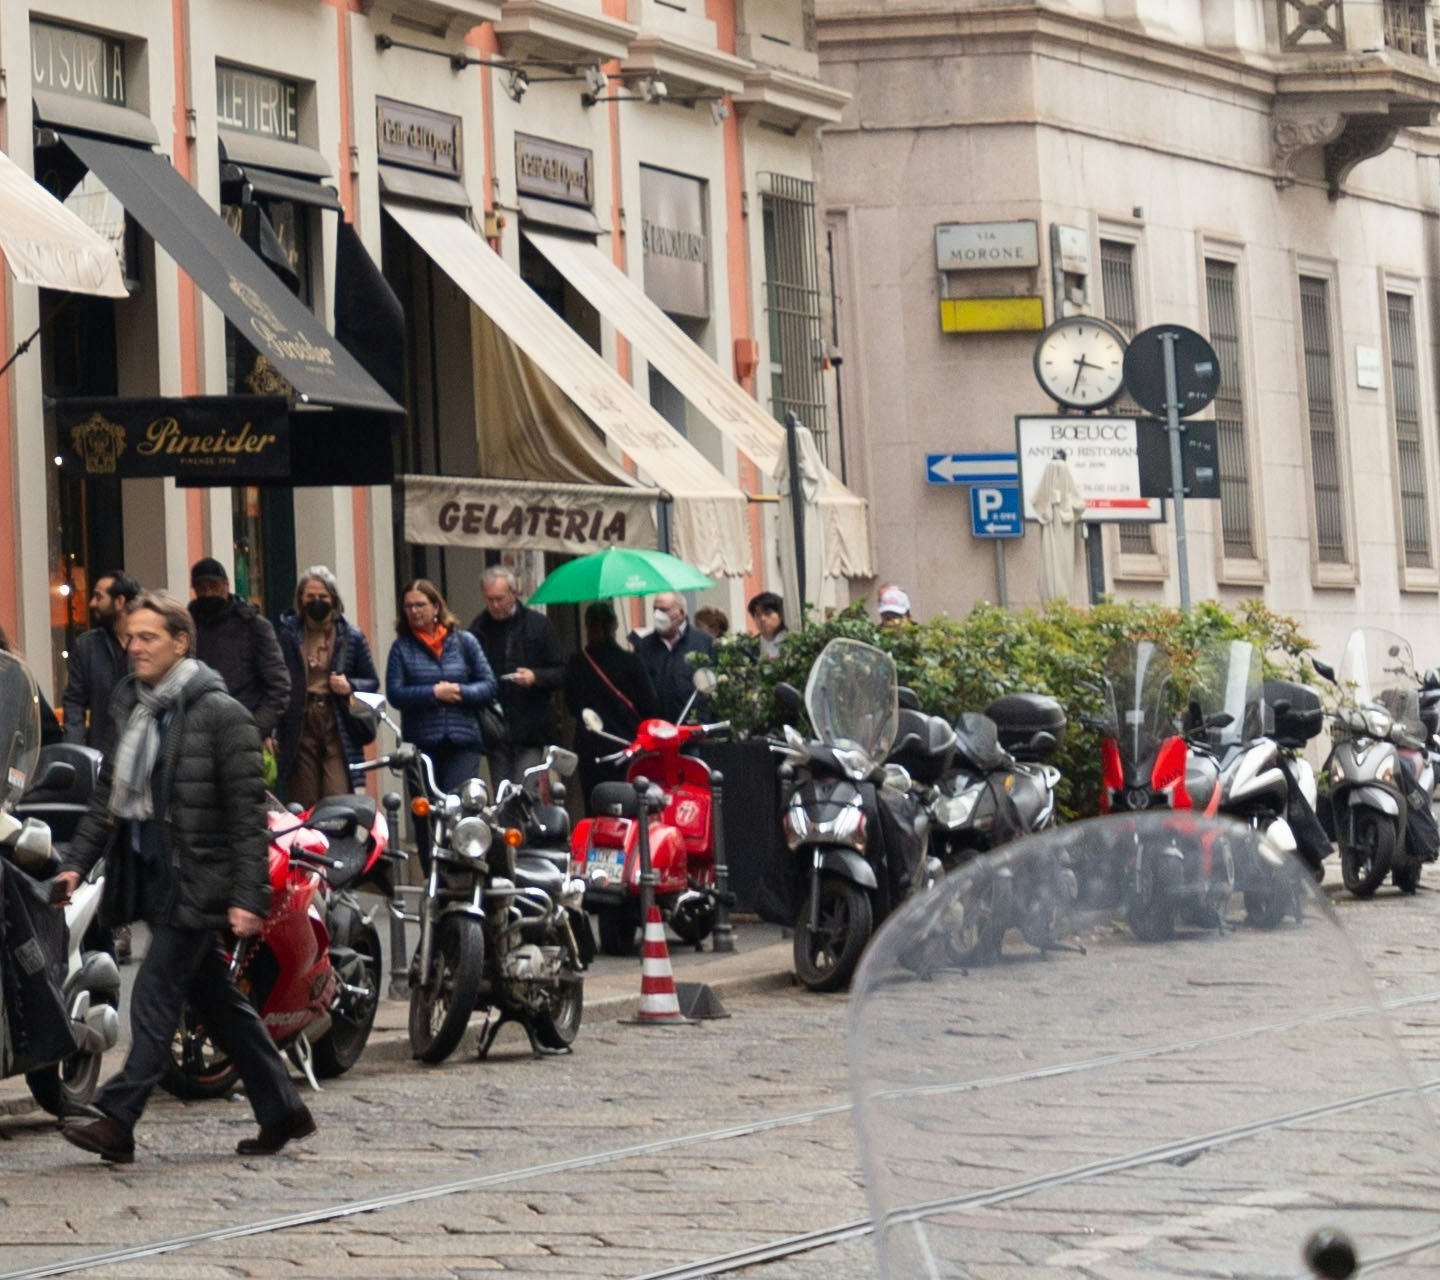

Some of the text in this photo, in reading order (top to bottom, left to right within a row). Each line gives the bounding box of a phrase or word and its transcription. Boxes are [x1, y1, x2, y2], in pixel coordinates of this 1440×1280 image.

[976, 231, 997, 240] VIA
[950, 246, 1025, 260] MORONE
[136, 416, 277, 456] Pineider
[978, 489, 1003, 521] P
[438, 501, 627, 543] GELATERIA
